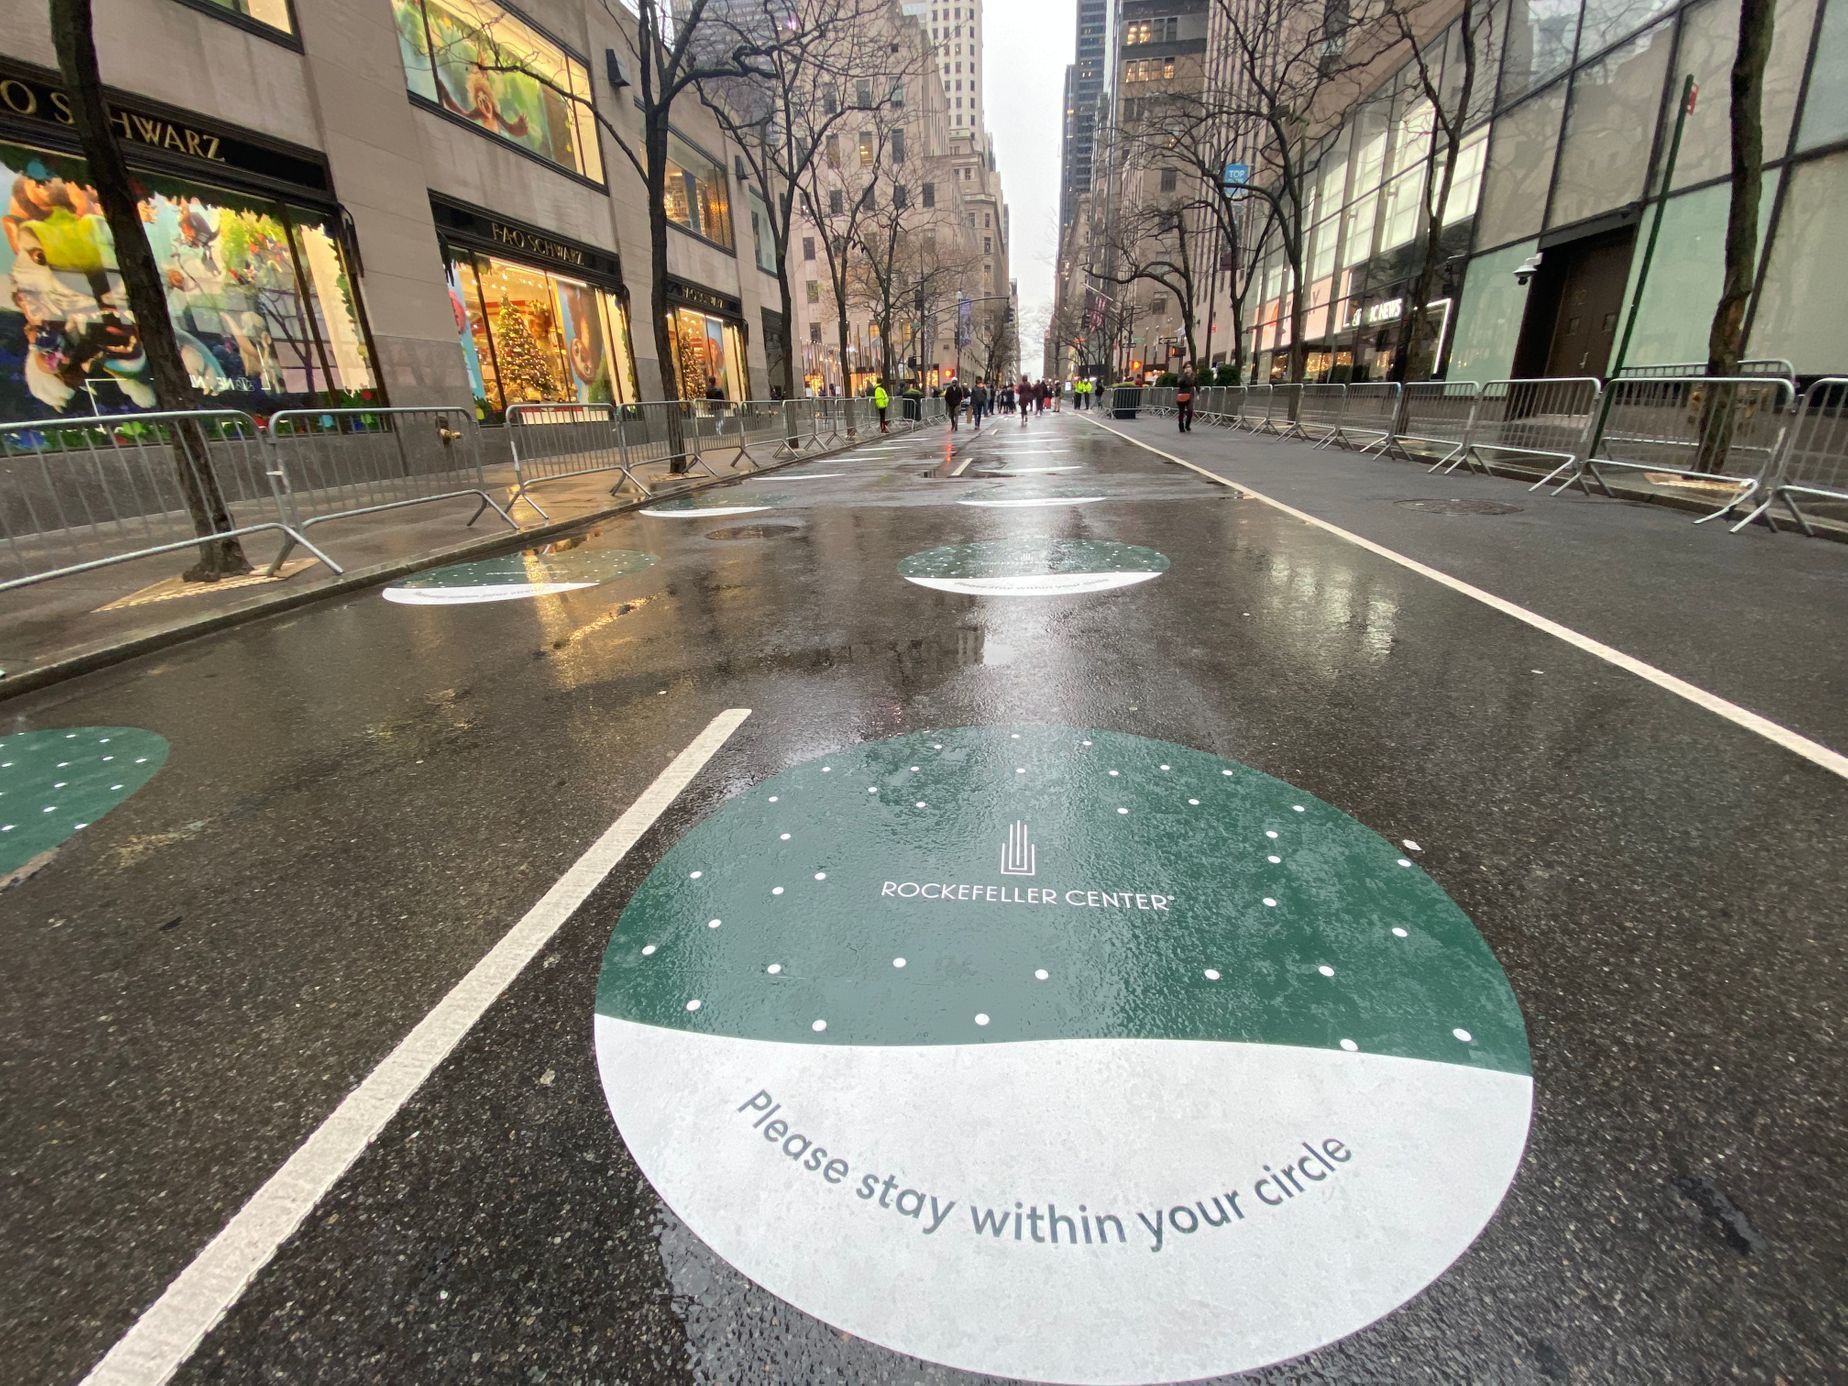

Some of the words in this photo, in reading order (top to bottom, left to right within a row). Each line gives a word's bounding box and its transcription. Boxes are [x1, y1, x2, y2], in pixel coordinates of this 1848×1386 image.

[50, 92, 225, 163] SHWARZ
[1229, 169, 1245, 179] TOP
[528, 234, 585, 266] SCHWARZ
[1379, 298, 1402, 320] NEWS
[881, 881, 1057, 904] ROCKEFELLER
[737, 1089, 849, 1184] Please
[856, 1172, 956, 1236] stay
[969, 1203, 1127, 1244] within
[1136, 1189, 1246, 1253] your
[1253, 1138, 1352, 1206] circle
